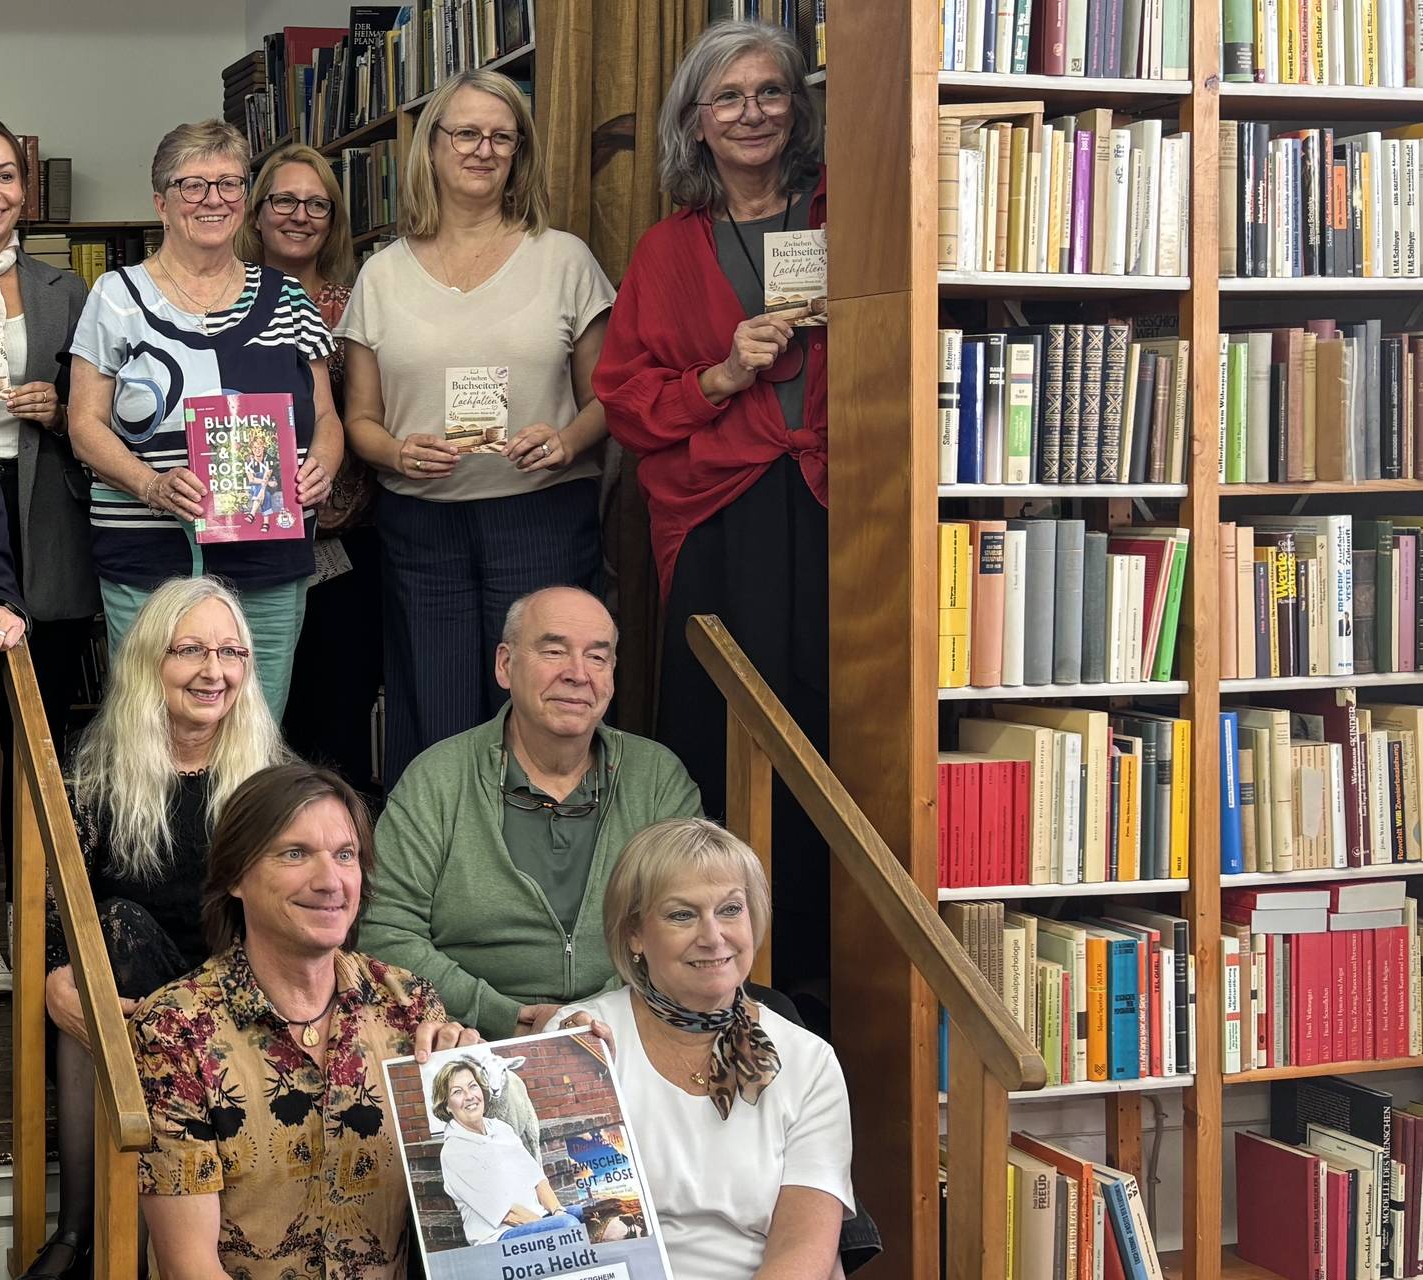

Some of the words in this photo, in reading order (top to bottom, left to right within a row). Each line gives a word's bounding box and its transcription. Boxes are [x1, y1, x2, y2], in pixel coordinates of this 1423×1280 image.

[772, 247, 825, 258] Buchseiten
[772, 261, 824, 277] Lachfalten
[452, 381, 498, 391] Buchseiten
[452, 393, 498, 409] Lachfalten
[204, 414, 276, 429] BLUMEN,
[943, 409, 952, 446] Silbermann
[206, 431, 250, 445] KOHL
[218, 447, 230, 459] &
[209, 478, 252, 492] ROLL
[1276, 552, 1288, 599] Werde
[1393, 743, 1402, 808] Zweierbeziehung
[1397, 828, 1405, 860] Rowohlt
[1382, 1106, 1392, 1158] MENSCHEN
[573, 1153, 629, 1174] ZWISCHEN
[1383, 1161, 1391, 1178] DES
[576, 1175, 598, 1189] GUT
[1037, 1173, 1048, 1210] FREUD
[1381, 1179, 1391, 1225] MODELLE
[502, 1235, 556, 1257] Lesung
[558, 1229, 584, 1246] mit
[501, 1263, 545, 1280] Dora
[548, 1249, 598, 1273] Heldt
